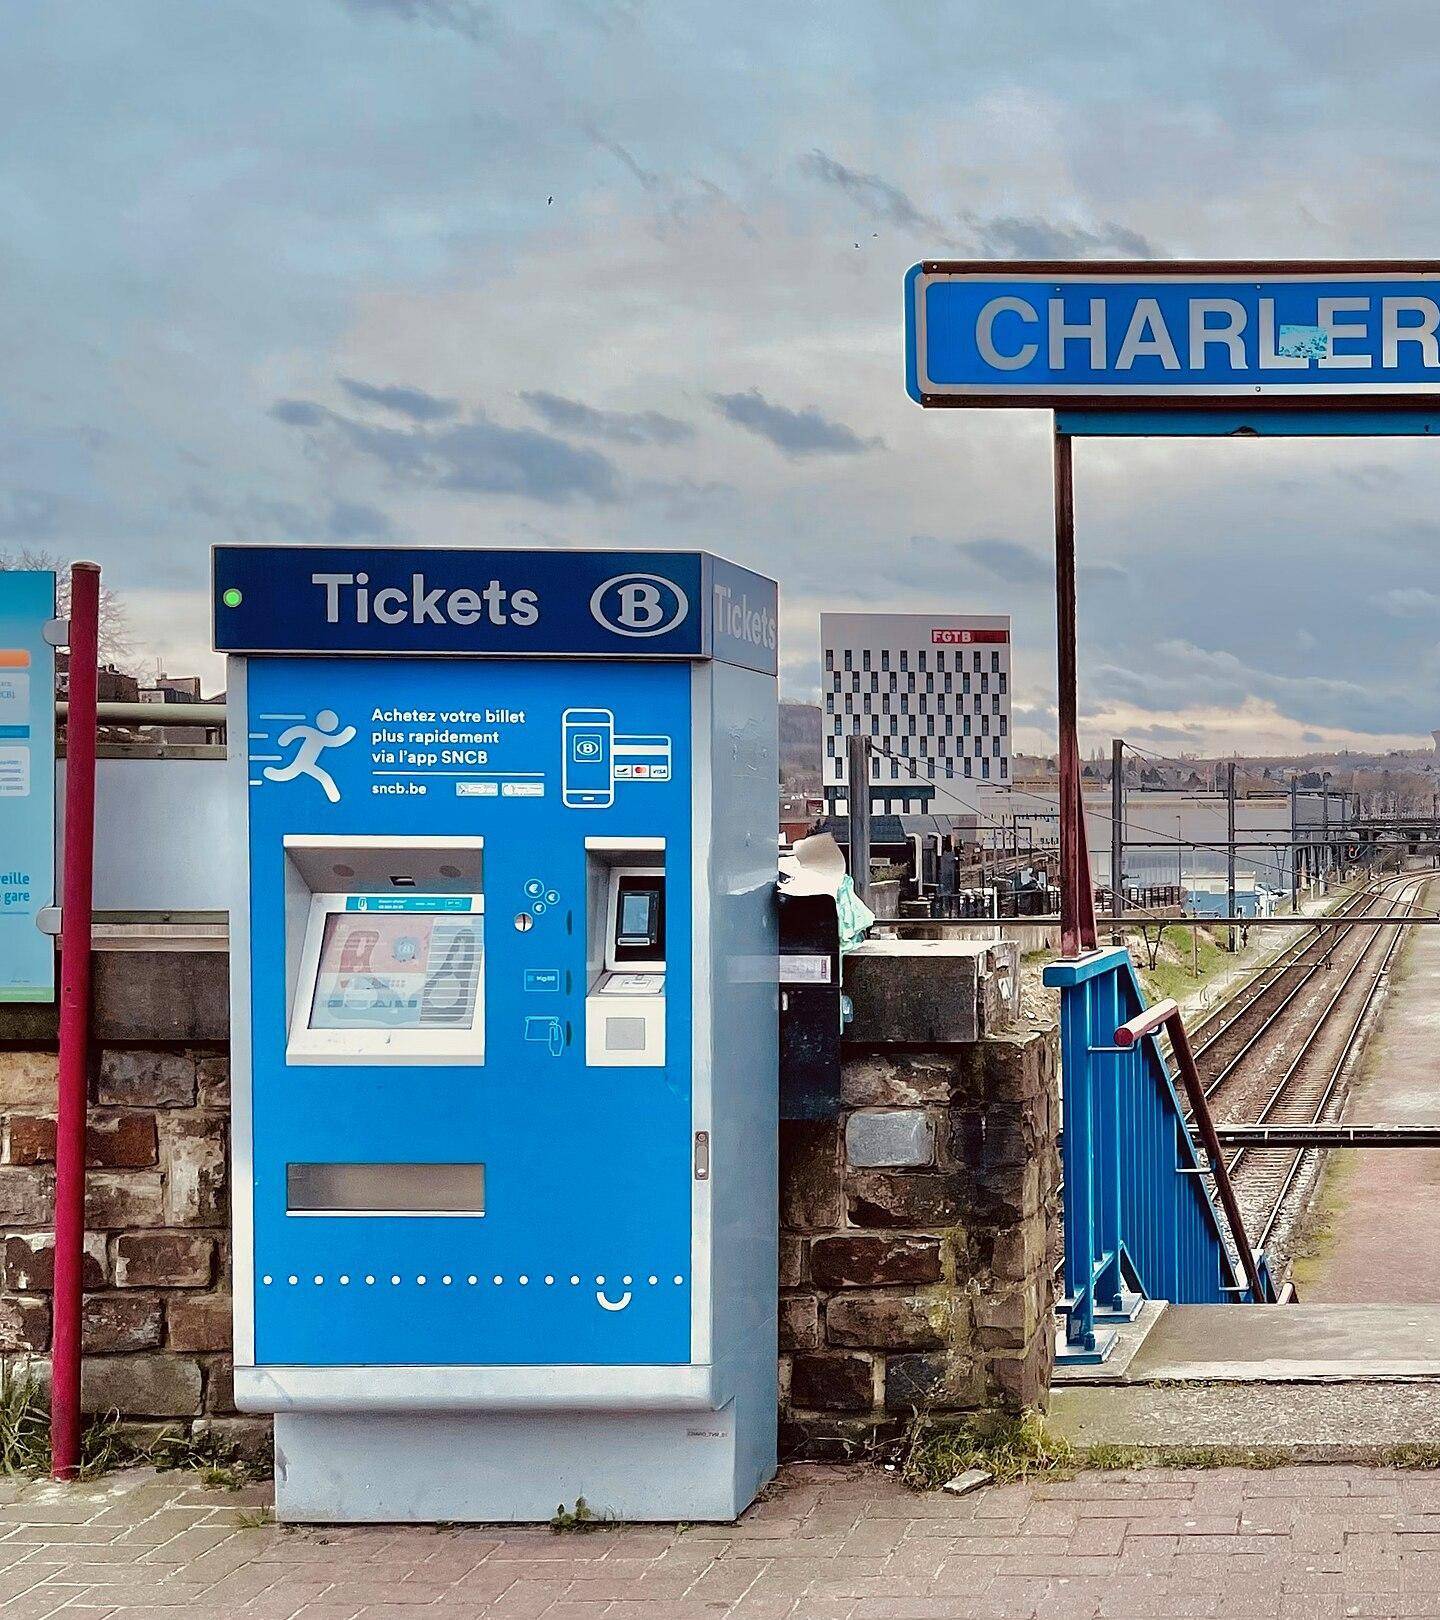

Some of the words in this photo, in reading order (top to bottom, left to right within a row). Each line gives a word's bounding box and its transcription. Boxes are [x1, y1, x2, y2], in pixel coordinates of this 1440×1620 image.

[312, 572, 539, 625] Tickets
[714, 584, 776, 650] Tickets
[933, 630, 972, 643] FGTB
[372, 708, 436, 722] Achetez
[440, 710, 481, 723] votre
[486, 709, 526, 724] billet
[372, 729, 404, 745] plus
[408, 729, 499, 746] rapidement
[372, 750, 395, 763] via
[399, 750, 438, 766] l'app
[441, 750, 488, 764] SNCB
[372, 782, 427, 795] sncb.be
[4, 892, 30, 906] gare
